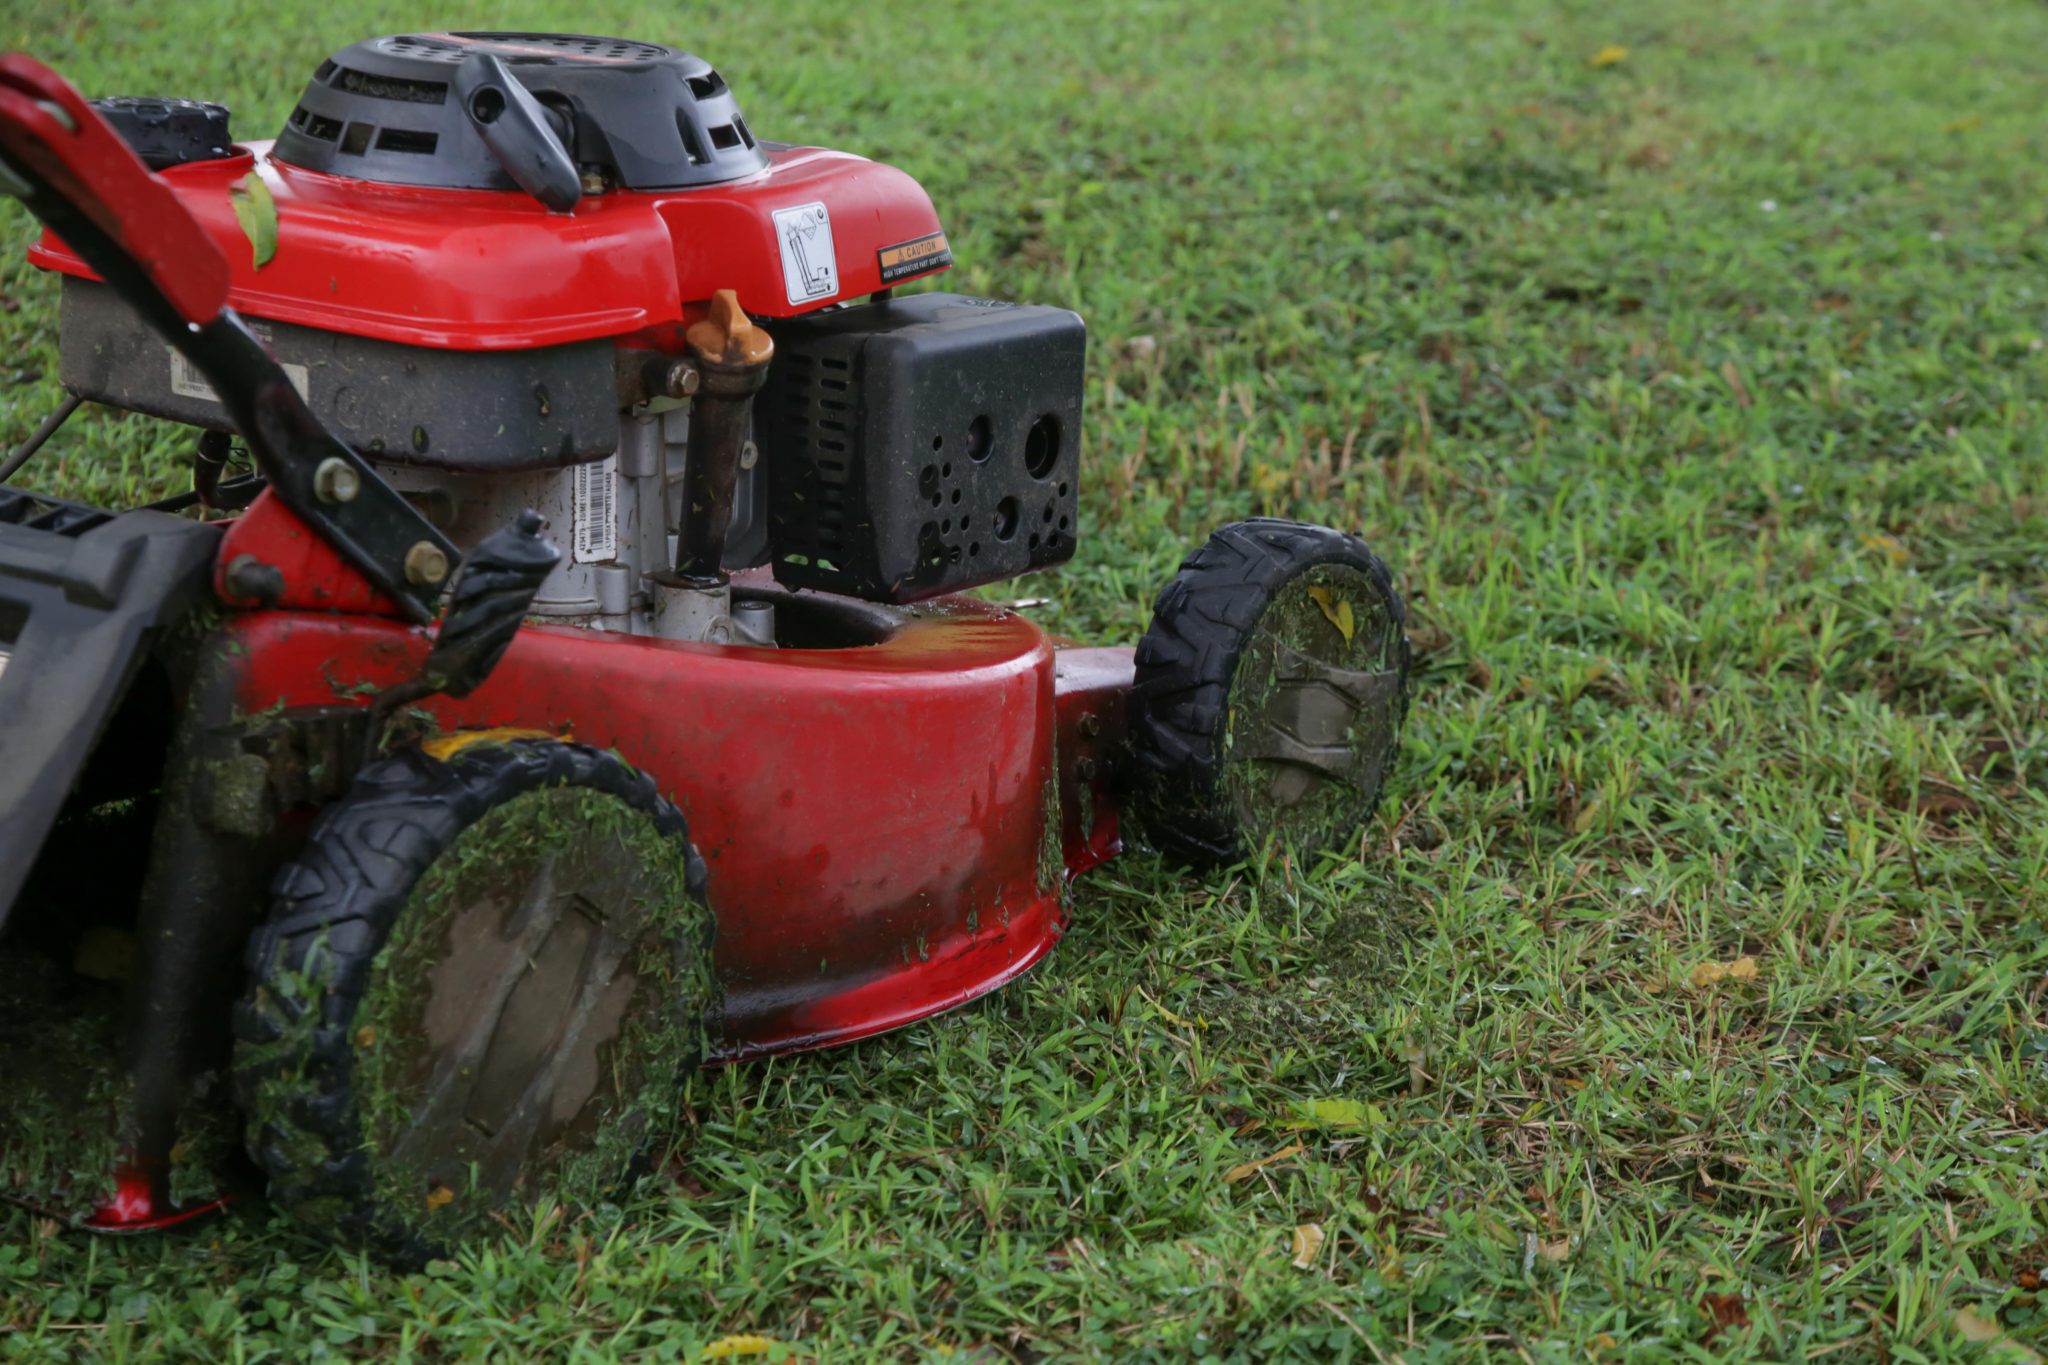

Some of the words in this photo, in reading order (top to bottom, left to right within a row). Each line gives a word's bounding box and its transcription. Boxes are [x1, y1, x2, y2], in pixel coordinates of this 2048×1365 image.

[906, 241, 936, 258] CAUTION
[894, 262, 919, 275] TEMPERATURE
[919, 259, 928, 268] PART
